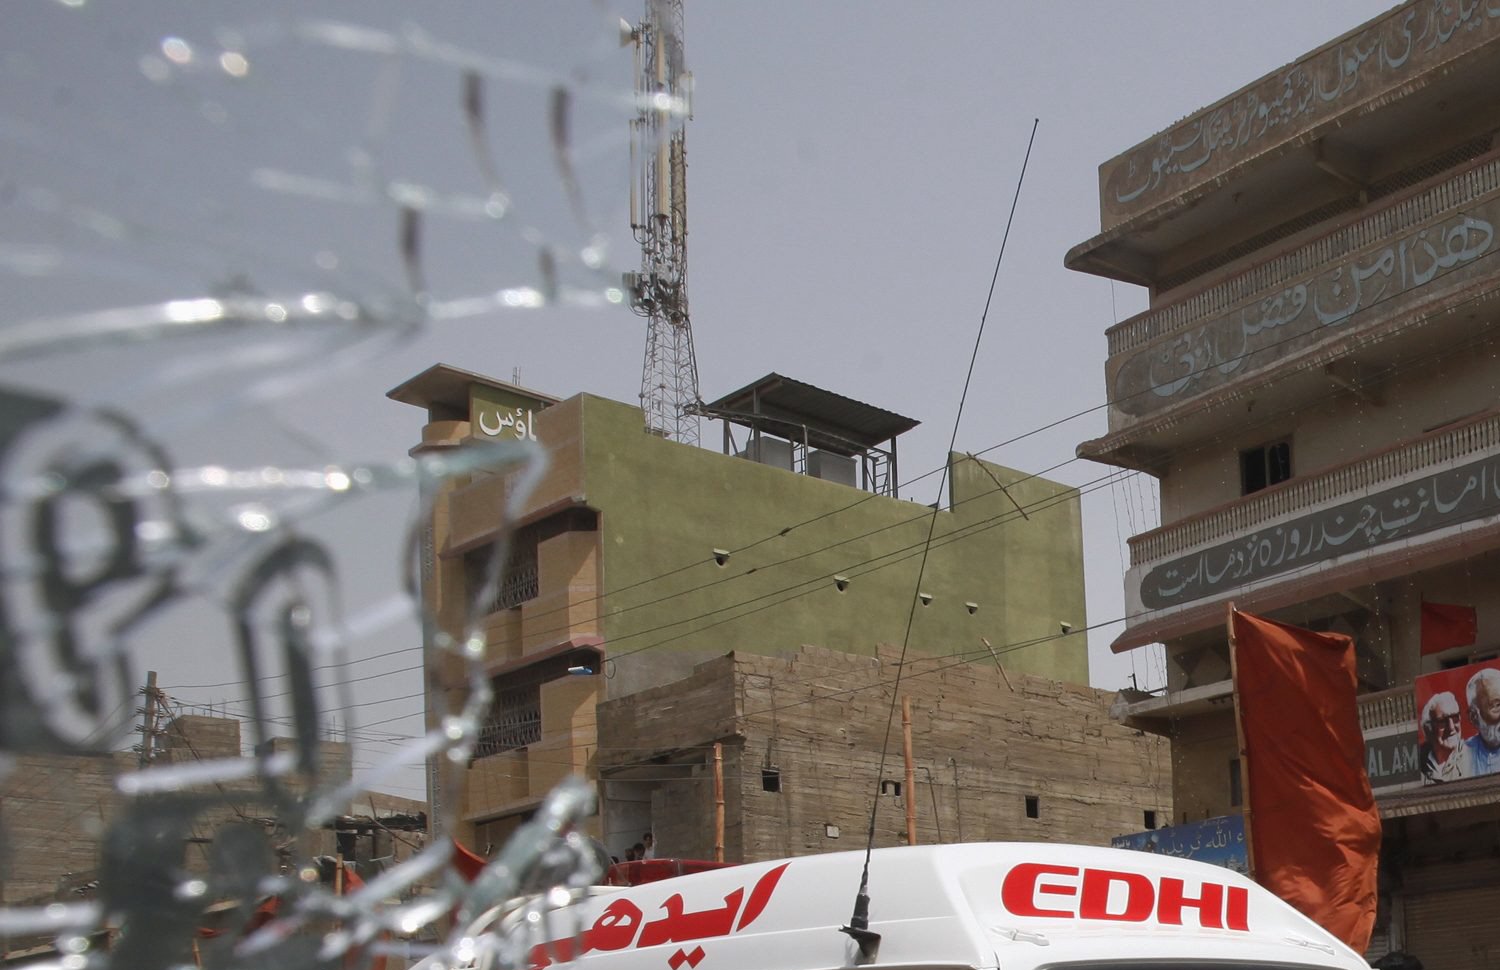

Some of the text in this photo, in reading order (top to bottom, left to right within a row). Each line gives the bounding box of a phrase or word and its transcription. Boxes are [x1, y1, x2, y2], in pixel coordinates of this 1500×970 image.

[1216, 277, 1314, 375] فضل
[1314, 252, 1396, 328] من
[479, 407, 538, 442] اؤس
[1001, 862, 1251, 932] EDHI
